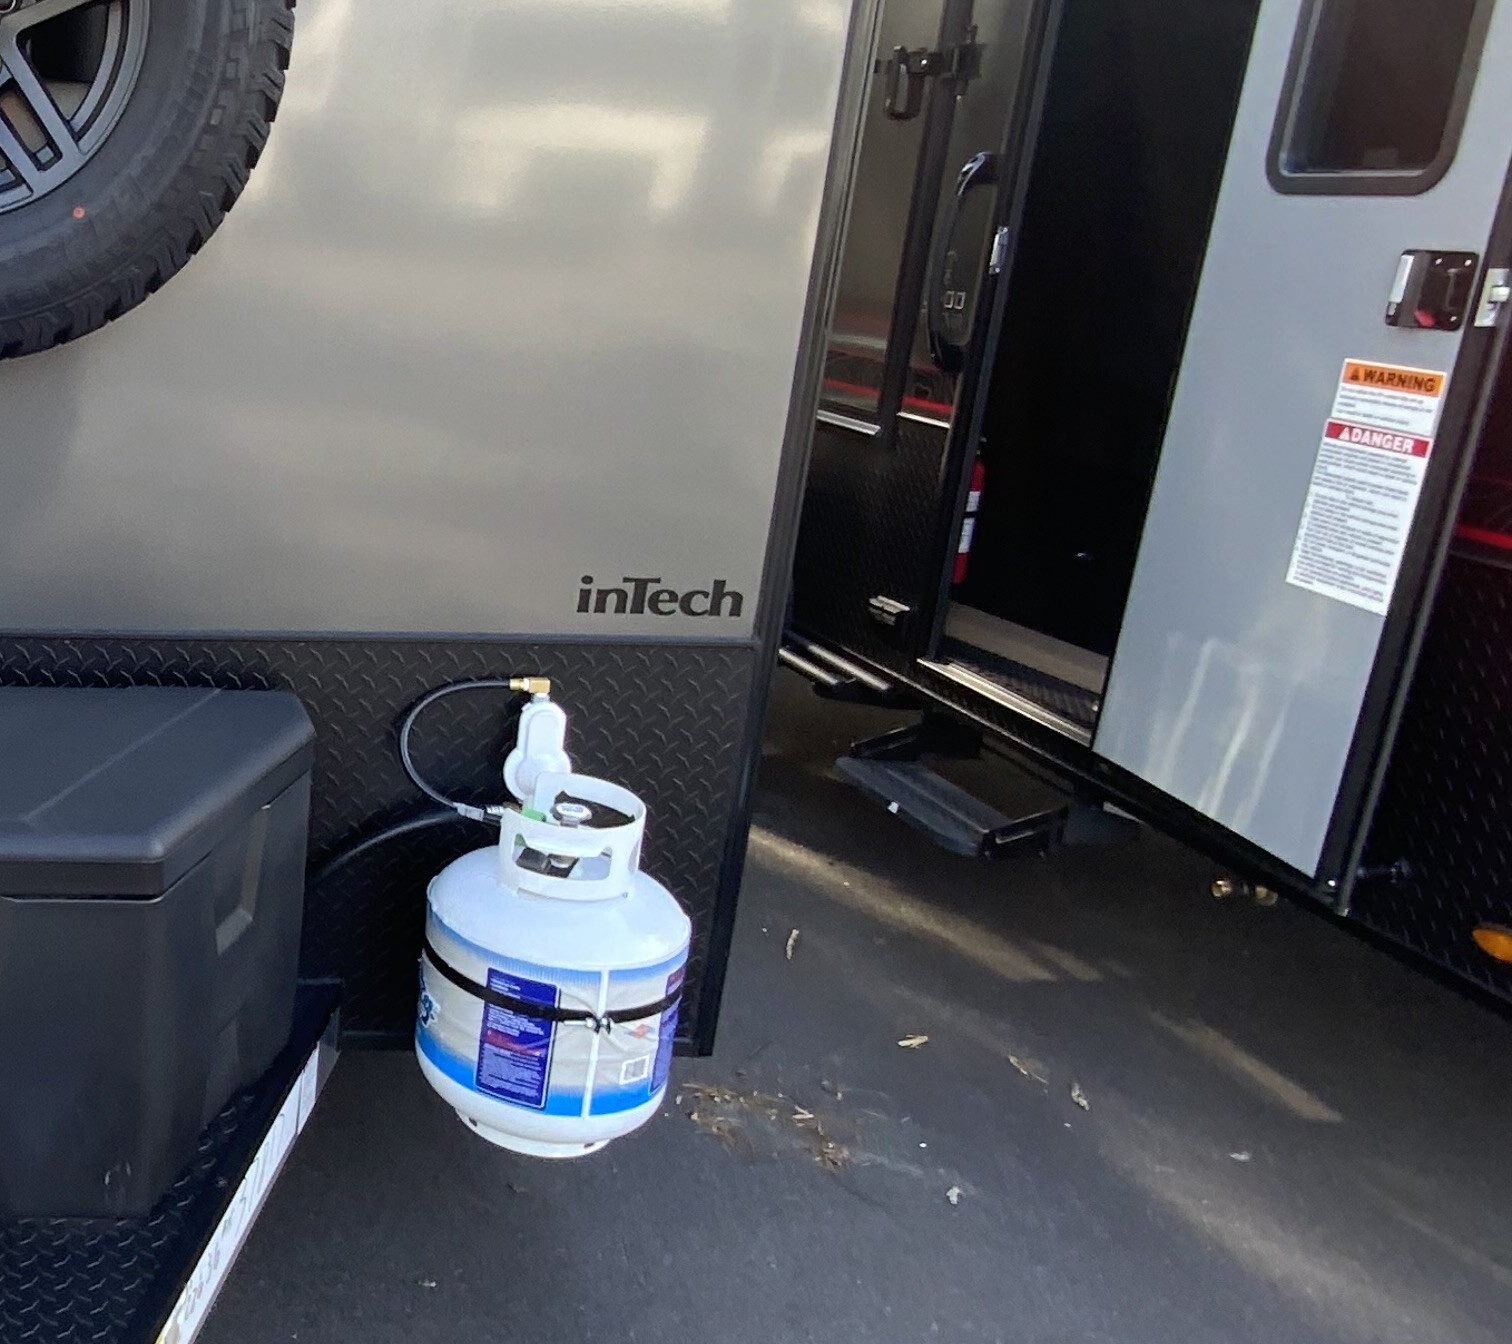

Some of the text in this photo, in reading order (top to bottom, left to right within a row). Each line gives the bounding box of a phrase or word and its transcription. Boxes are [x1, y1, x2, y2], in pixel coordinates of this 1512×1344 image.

[1363, 368, 1436, 393] WARNING
[1350, 427, 1415, 454] DANGER
[576, 575, 744, 617] inTech
